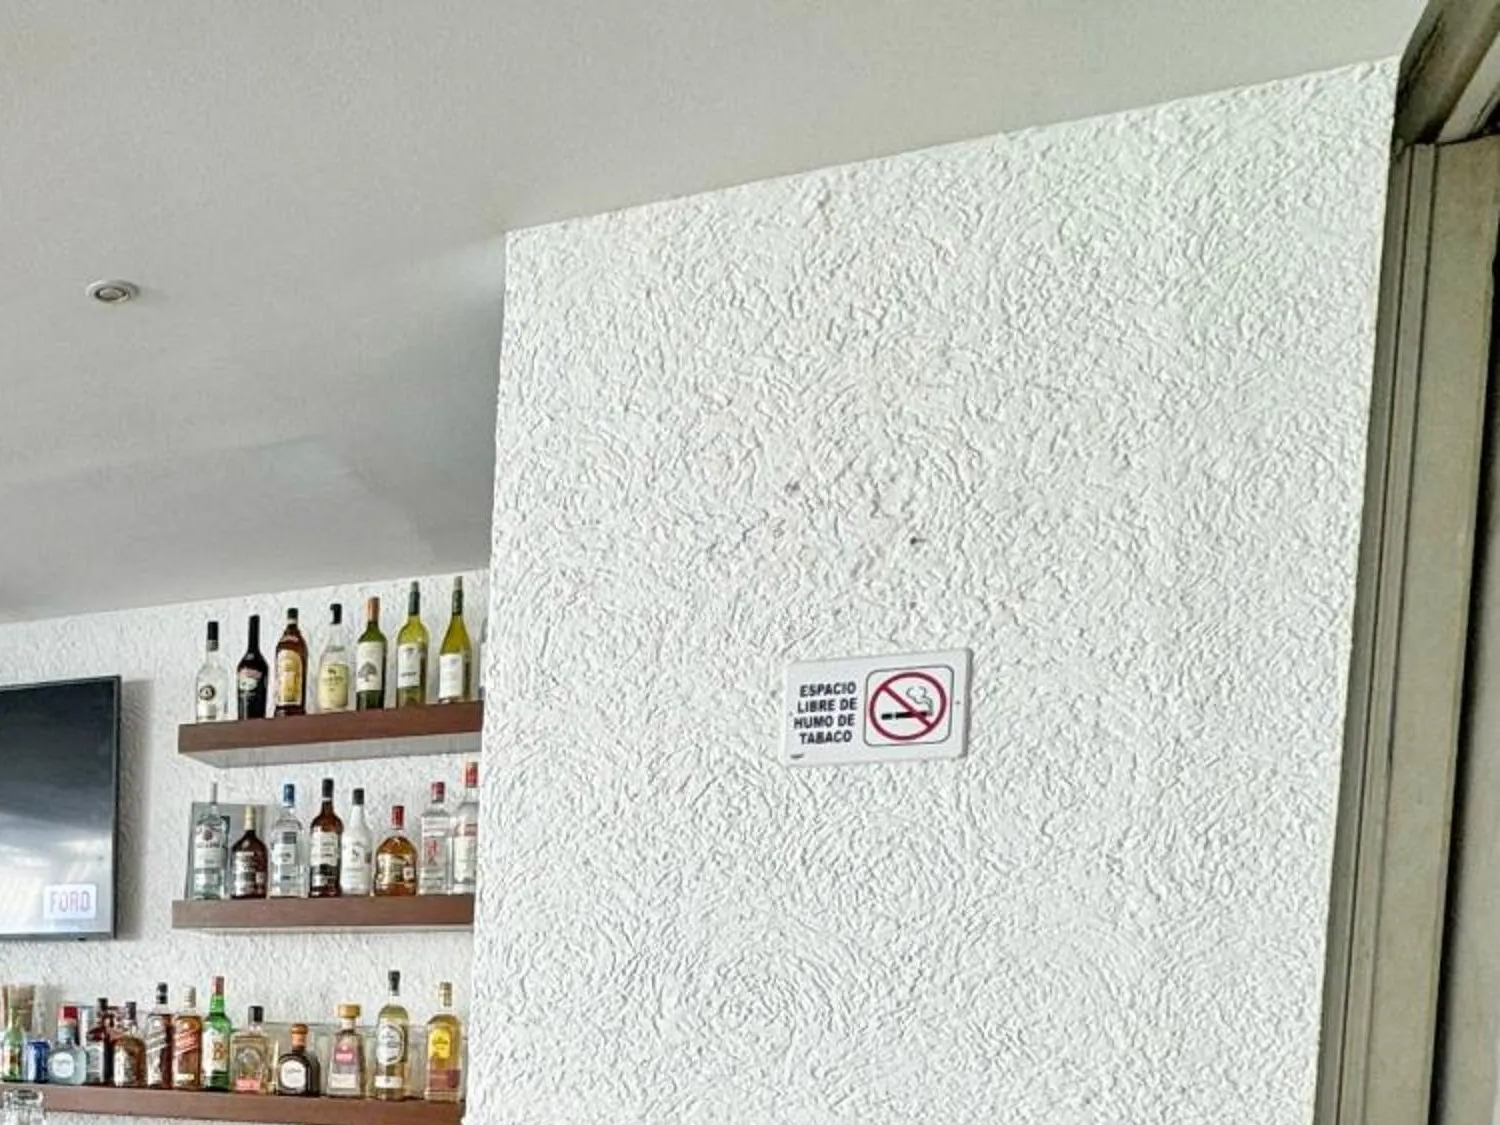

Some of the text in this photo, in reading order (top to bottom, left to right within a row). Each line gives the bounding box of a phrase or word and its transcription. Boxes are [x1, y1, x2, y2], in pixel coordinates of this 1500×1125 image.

[799, 681, 857, 698] ESPACIO
[797, 697, 858, 714] LIBRE DE
[793, 713, 856, 730] HUMO DE
[799, 730, 852, 745] TABACO
